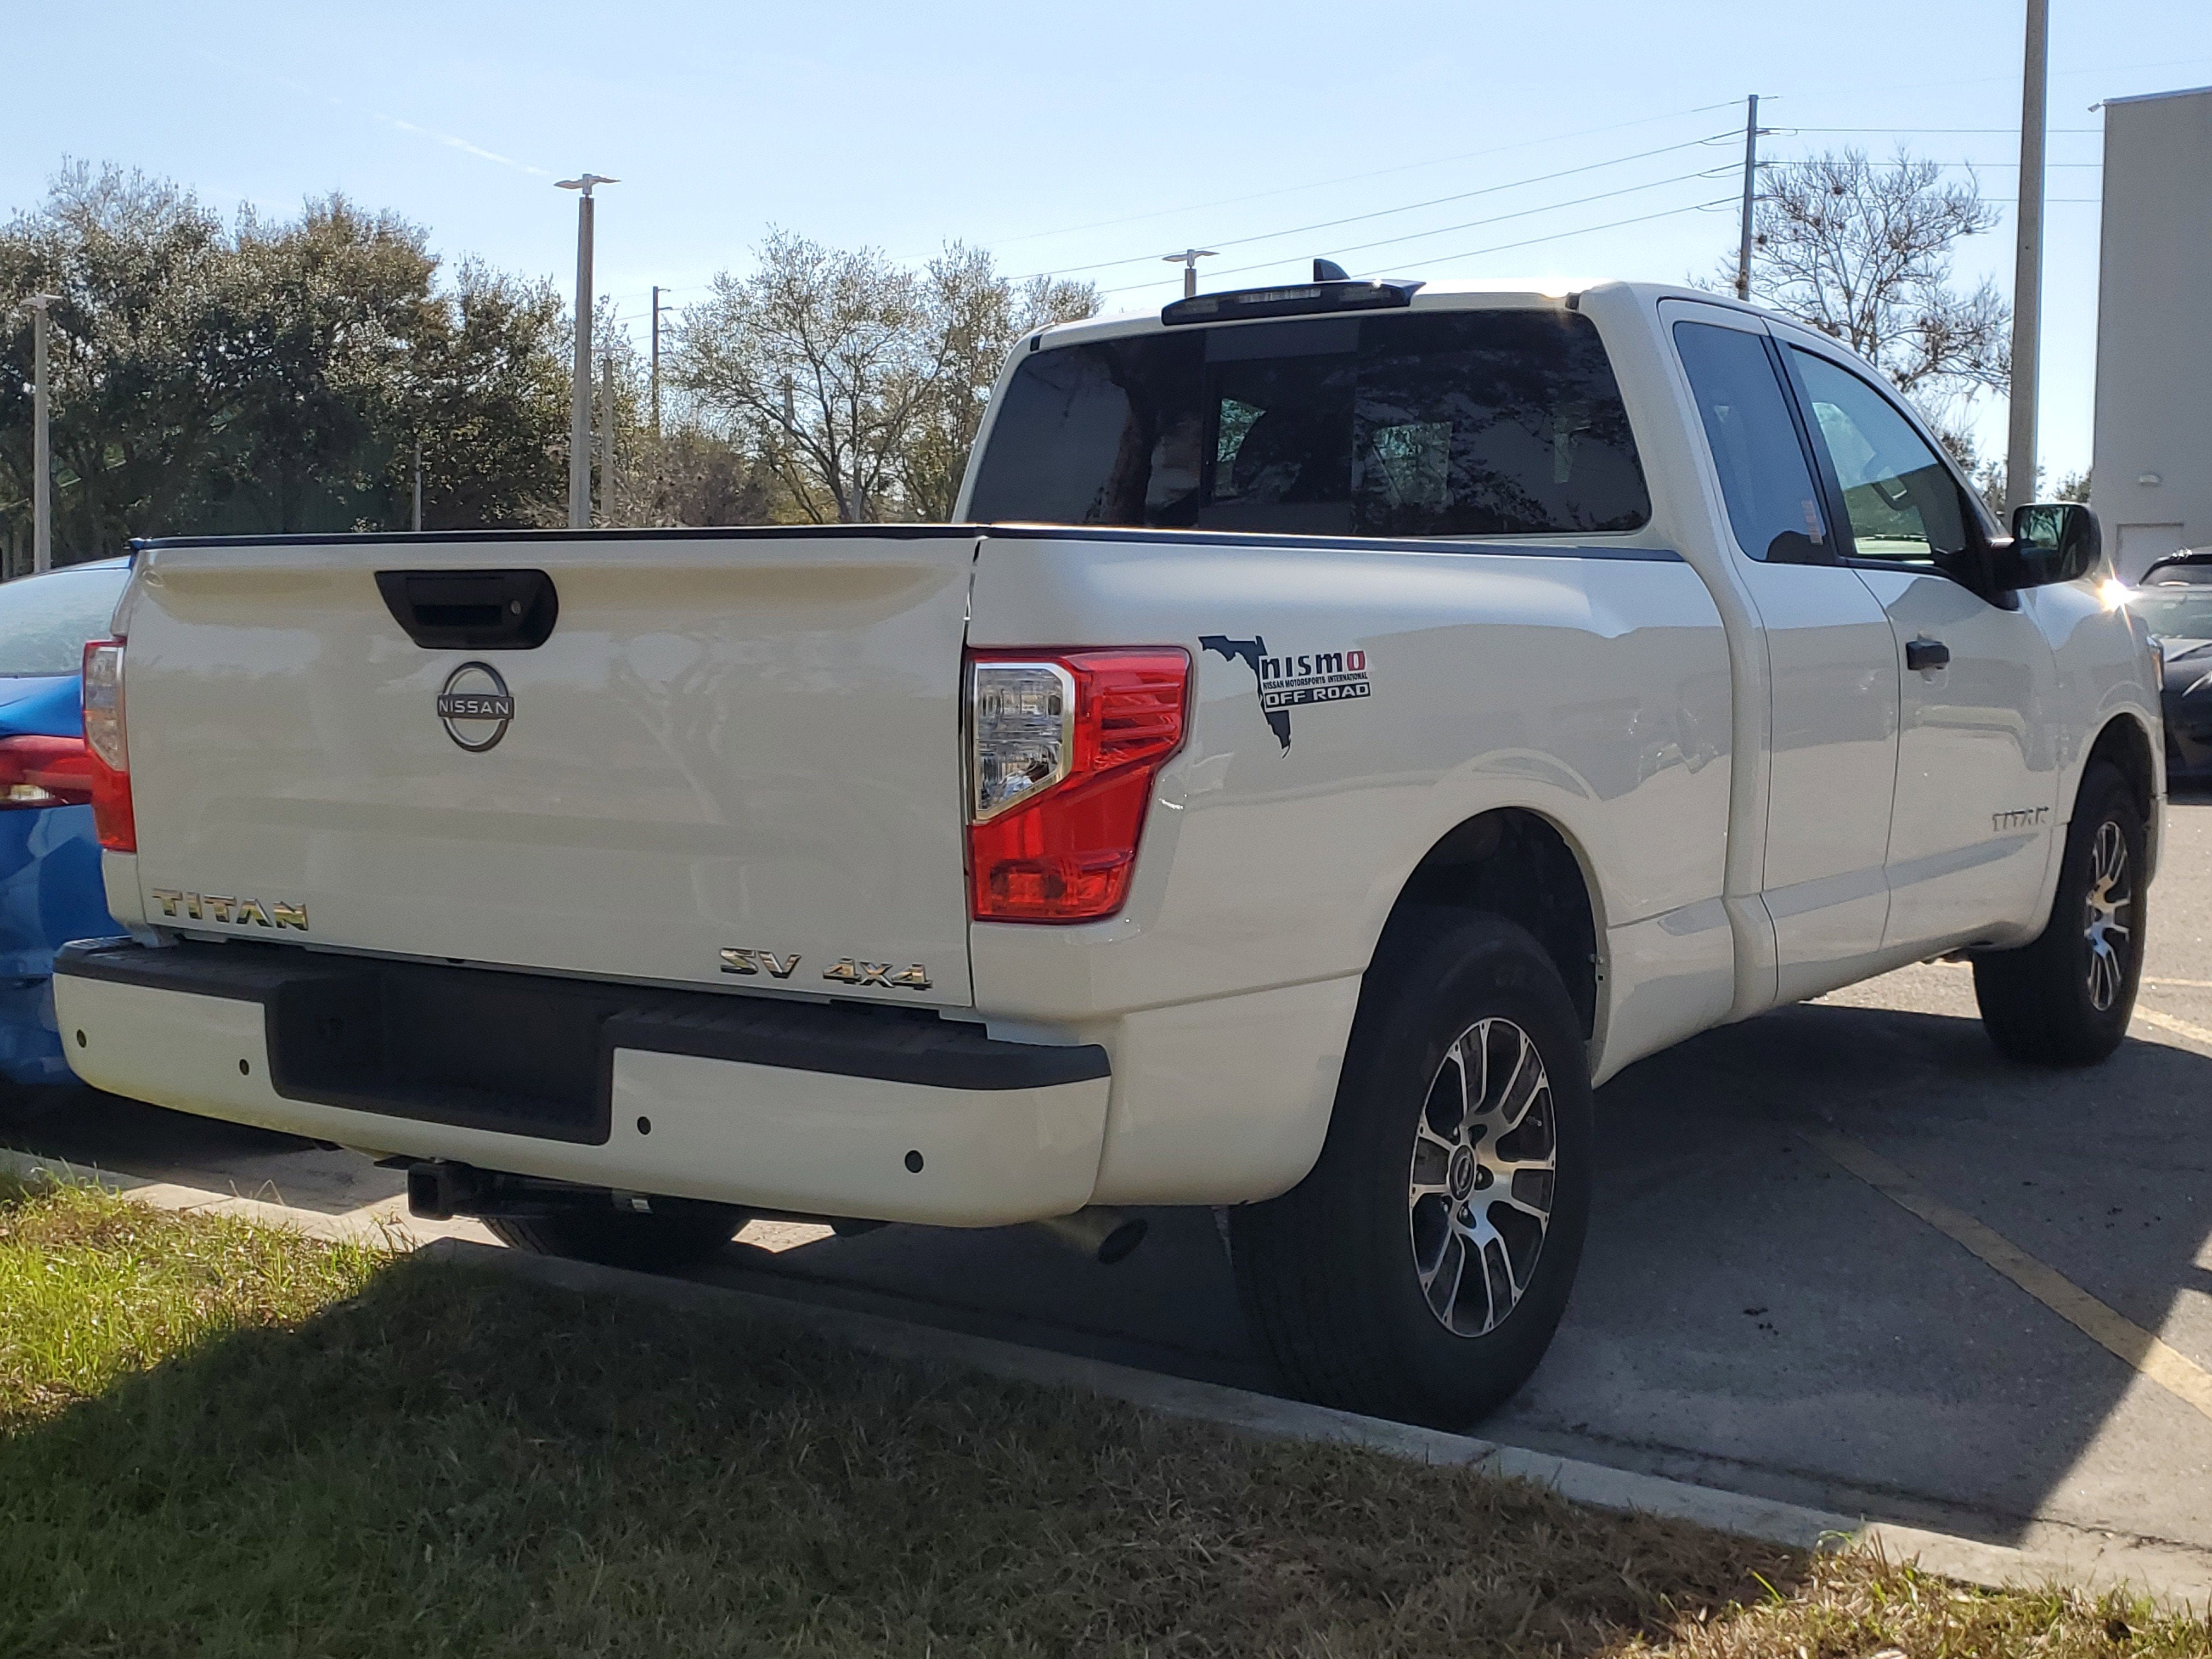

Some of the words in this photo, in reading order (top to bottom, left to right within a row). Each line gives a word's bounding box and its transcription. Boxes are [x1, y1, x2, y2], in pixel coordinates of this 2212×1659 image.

[1261, 651, 1366, 680] nismo
[1263, 681, 1284, 690] NISSAN
[1285, 676, 1325, 687] MOTORSPORTS
[1328, 672, 1368, 682] INTERNATIONAL
[439, 699, 510, 714] NISSAN
[1266, 691, 1306, 706] OFF
[1313, 684, 1369, 701] ROAD
[152, 888, 309, 931] TITAN
[720, 947, 802, 979] SV
